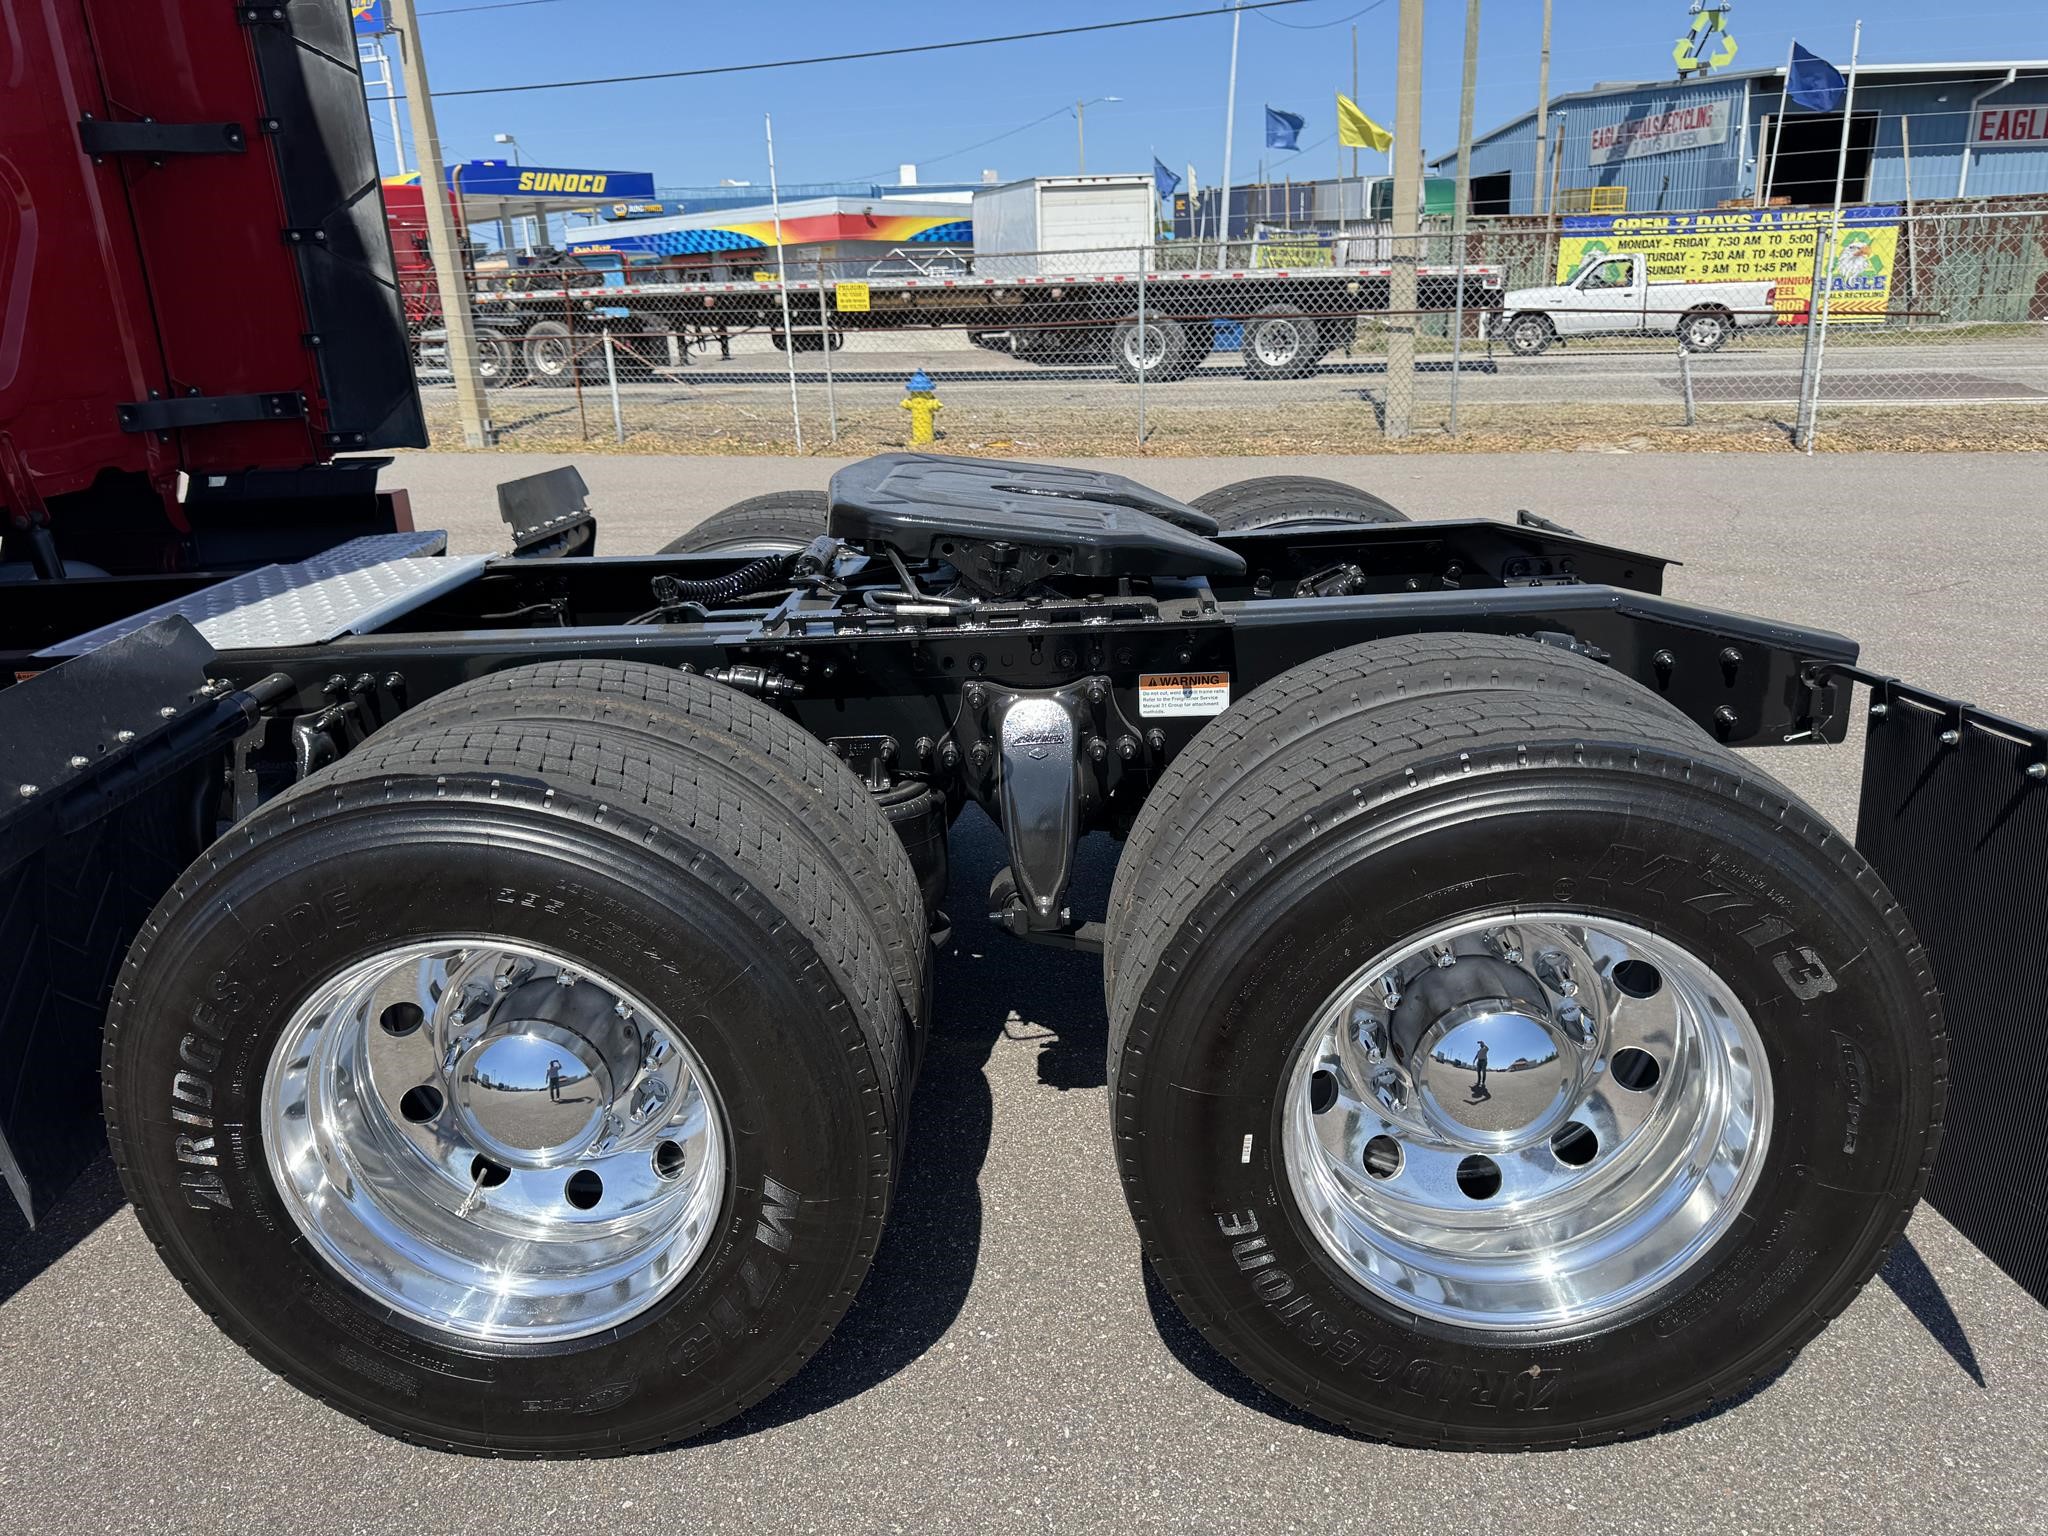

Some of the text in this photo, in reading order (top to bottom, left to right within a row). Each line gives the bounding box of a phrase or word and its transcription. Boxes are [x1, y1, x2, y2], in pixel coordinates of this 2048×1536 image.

[1592, 123, 1622, 150] EAGLE
[518, 172, 607, 193] SUNOCO
[1612, 210, 1846, 235] OPEN 7 DAYS A WEEK
[1617, 239, 1662, 249] MONDAY
[1673, 237, 1710, 248] FRIDAY
[1717, 236, 1740, 247] 7:30
[1743, 235, 1761, 246] AM
[1769, 234, 1782, 245] TO
[1789, 233, 1813, 244] 5:00
[1647, 252, 1686, 262] TURDAY
[1701, 250, 1724, 260] 7:30
[1727, 250, 1745, 260] AM
[1752, 249, 1766, 258] TO
[1768, 248, 1793, 258] 4:00
[1797, 247, 1814, 258] PM
[1647, 265, 1687, 275] SUNDAY
[1702, 264, 1709, 274] 9
[1711, 264, 1729, 273] AM
[1736, 263, 1750, 273] TO
[1754, 262, 1776, 272] 1:45
[1780, 261, 1797, 272] PM
[1819, 276, 1886, 291] EAGLE
[1845, 290, 1884, 298] RECYCLING
[1159, 675, 1220, 687] WARNING
[172, 885, 360, 1210] BRIDGESTONE
[669, 1173, 801, 1378] M713
[1216, 1207, 1562, 1413] BRIDGESTONE
